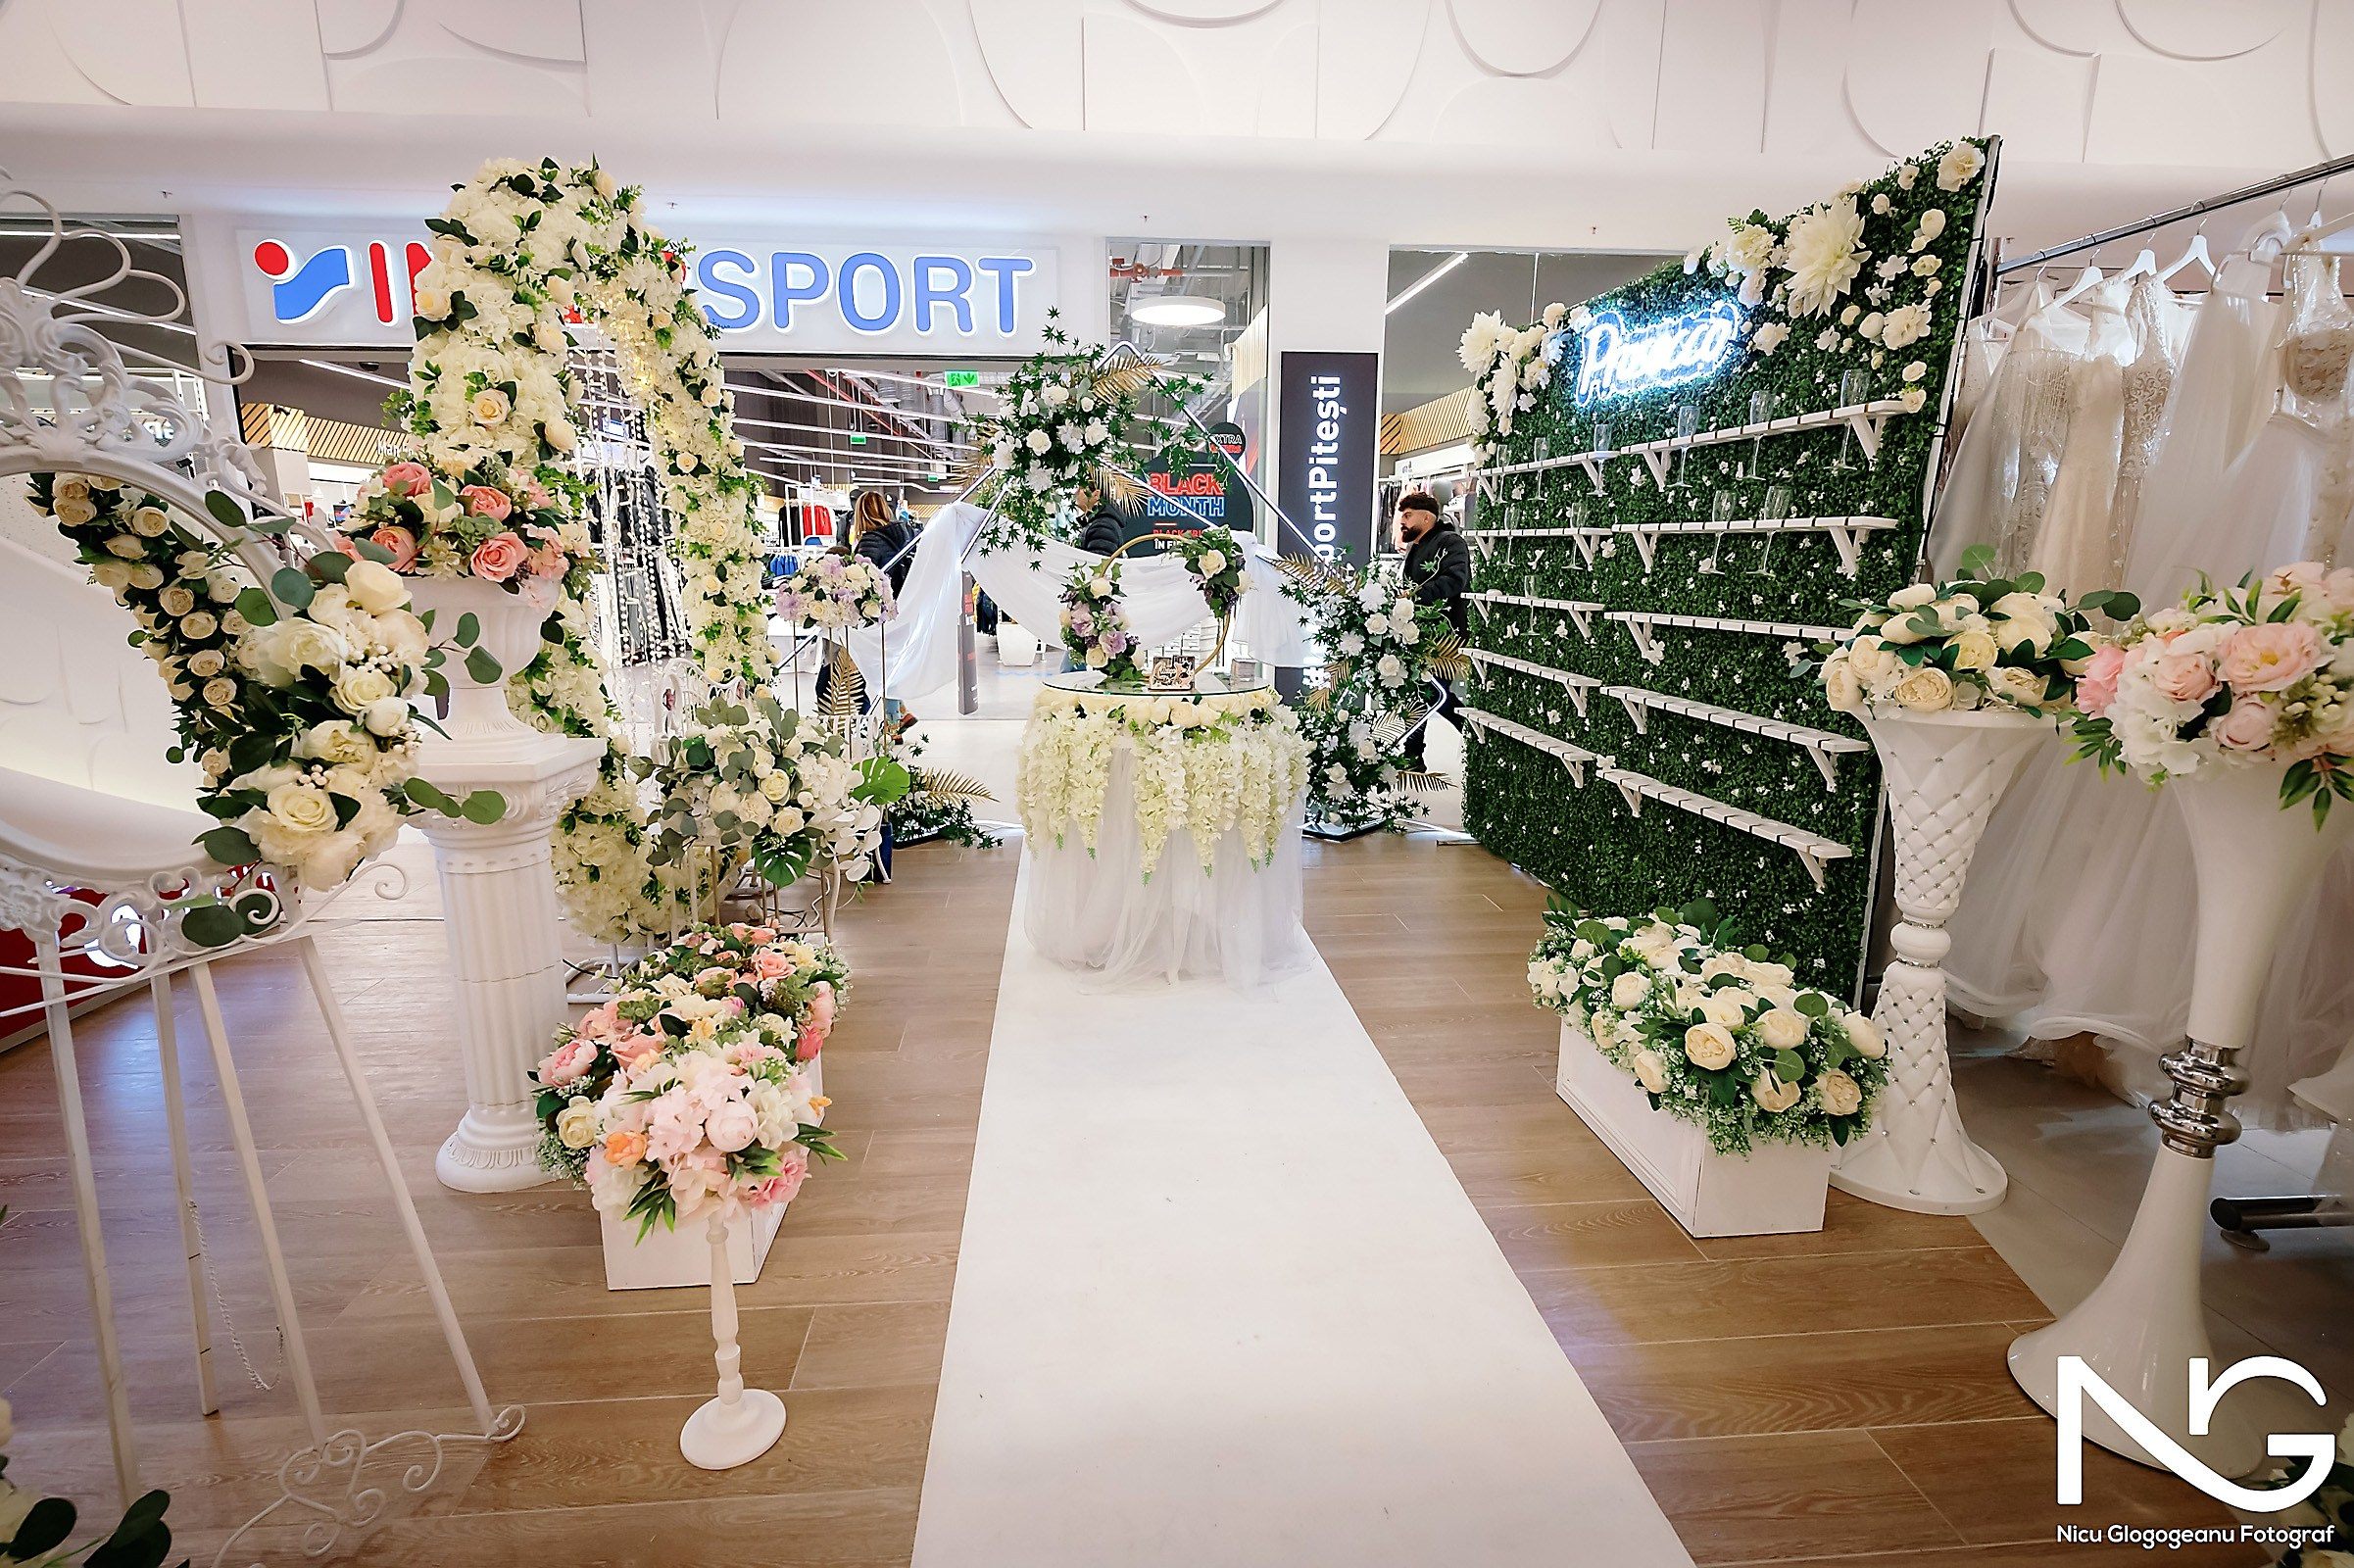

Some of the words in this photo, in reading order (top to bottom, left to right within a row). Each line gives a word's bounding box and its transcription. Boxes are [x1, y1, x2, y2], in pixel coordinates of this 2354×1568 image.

[368, 240, 1036, 336] ISPORT
[1579, 310, 1735, 399] Procco
[1211, 433, 1243, 445] XTRA
[1148, 472, 1225, 496] BLACK
[1147, 496, 1225, 516] MONTH
[1154, 538, 1165, 549] ÎN
